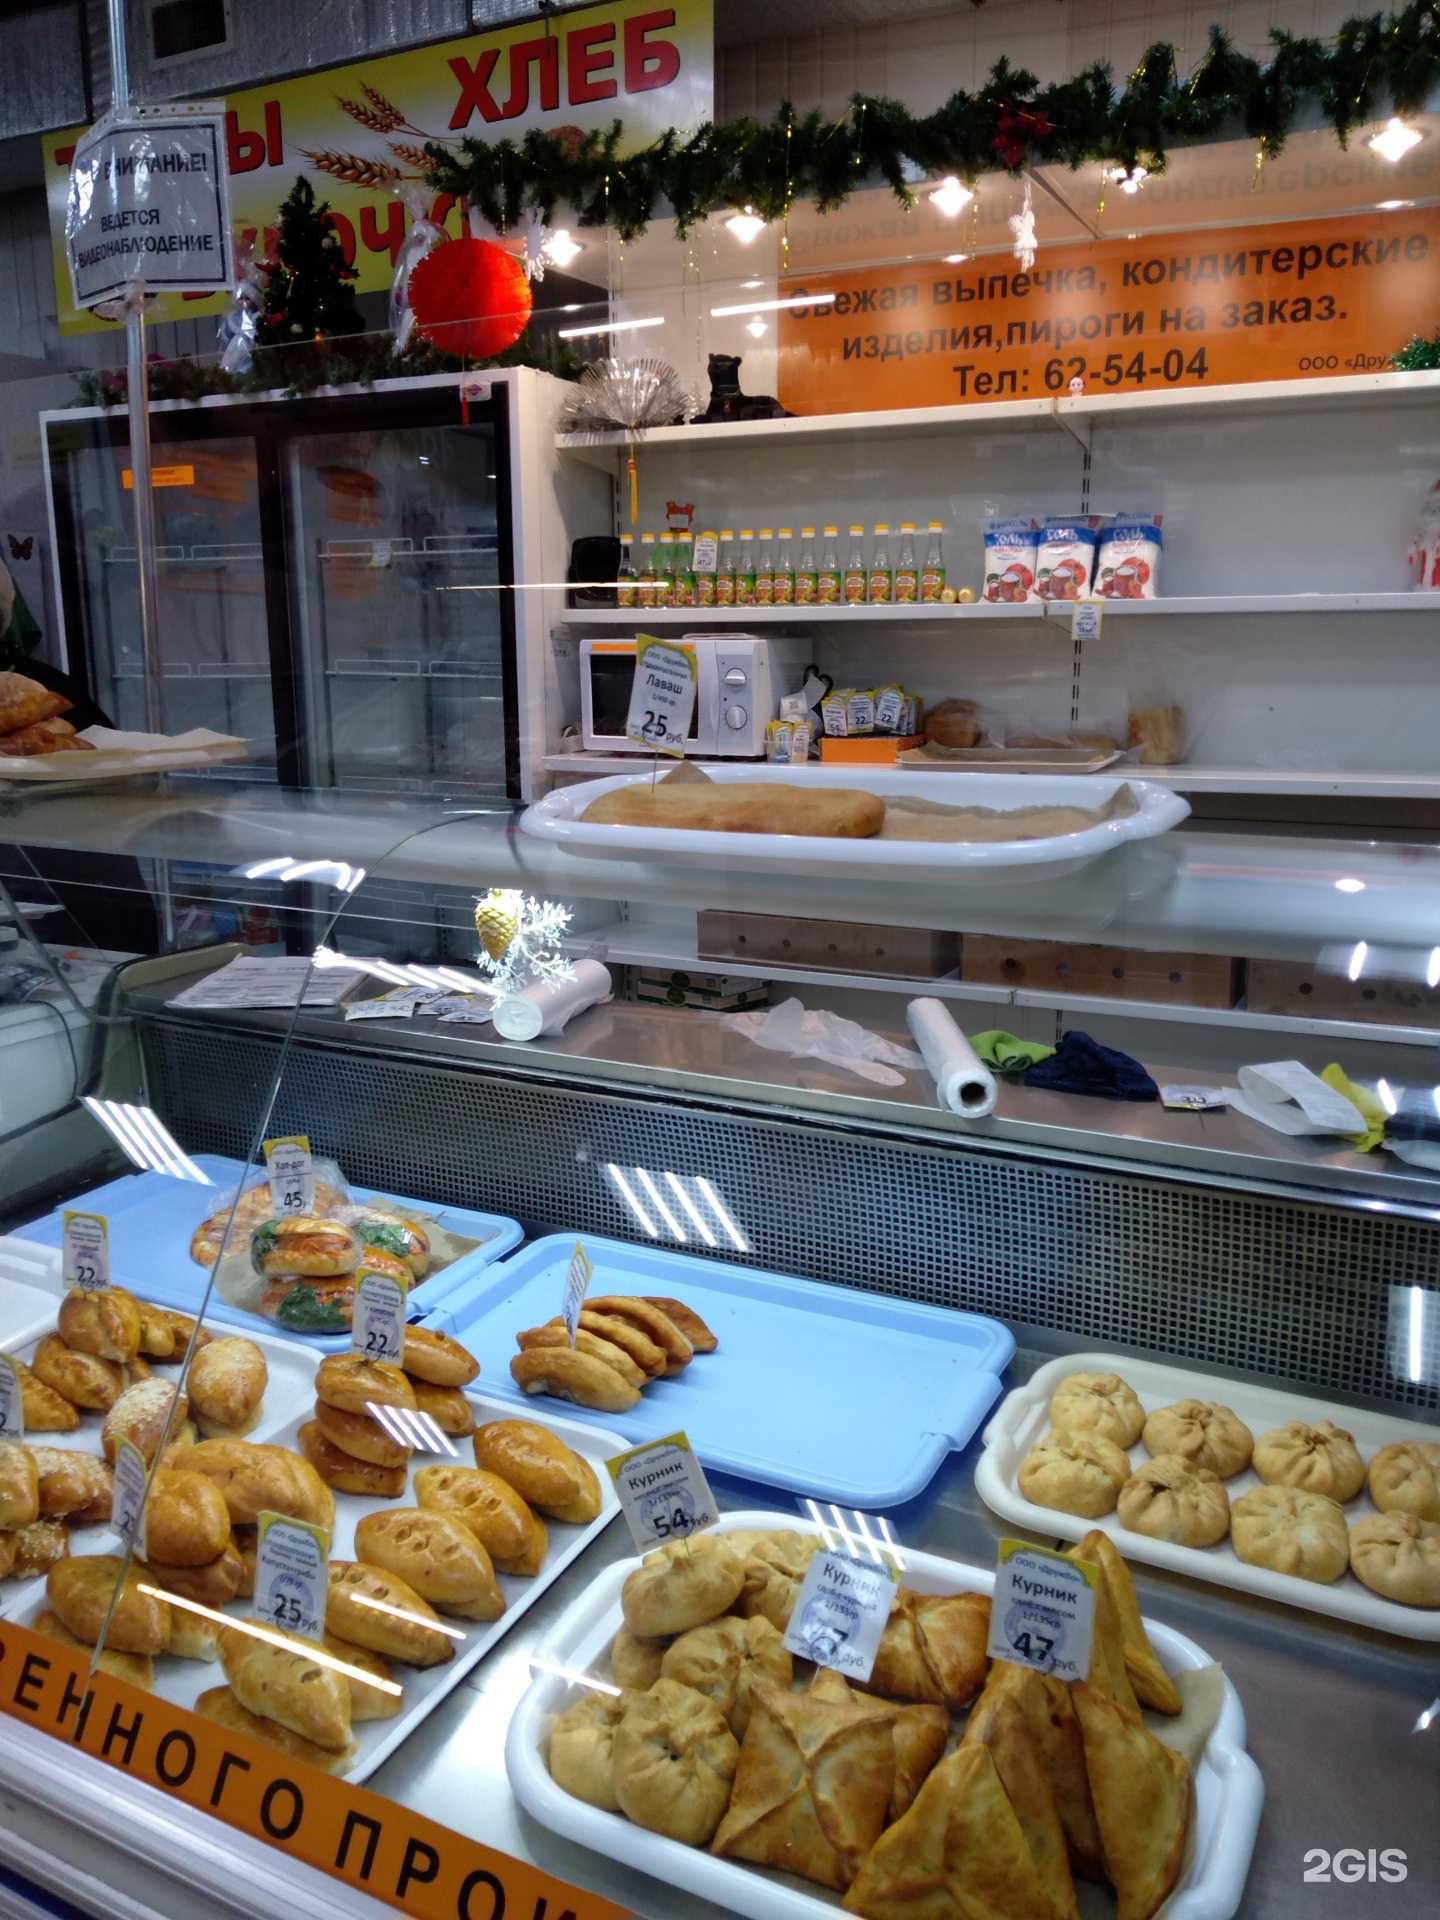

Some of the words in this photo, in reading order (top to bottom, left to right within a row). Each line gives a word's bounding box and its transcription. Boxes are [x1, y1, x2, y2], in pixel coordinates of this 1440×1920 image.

[447, 8, 681, 130] ХЛЕБ
[100, 208, 160, 233] ВЕДЕТСЯ
[787, 283, 919, 321] Свежая
[932, 264, 1107, 305] выпечка,
[1122, 233, 1430, 288] кондитерские
[1160, 305, 1207, 334] на
[1219, 294, 1349, 330] заказ.
[953, 363, 1030, 397] Тел:
[1044, 346, 1210, 391] 62-54-04
[1299, 355, 1338, 370] ООО
[646, 673, 684, 695] Лаваш
[641, 710, 668, 737] 25
[284, 1191, 303, 1208] 45
[77, 1265, 96, 1285] 22
[366, 1330, 388, 1354] 22
[628, 1461, 685, 1491] Курник
[653, 1507, 689, 1539] 54
[823, 1562, 880, 1597] Курник
[1012, 1573, 1078, 1605] Курник
[274, 1592, 302, 1623] 25
[1013, 1631, 1054, 1661] 47
[0, 1640, 304, 1840] ЕННОГО
